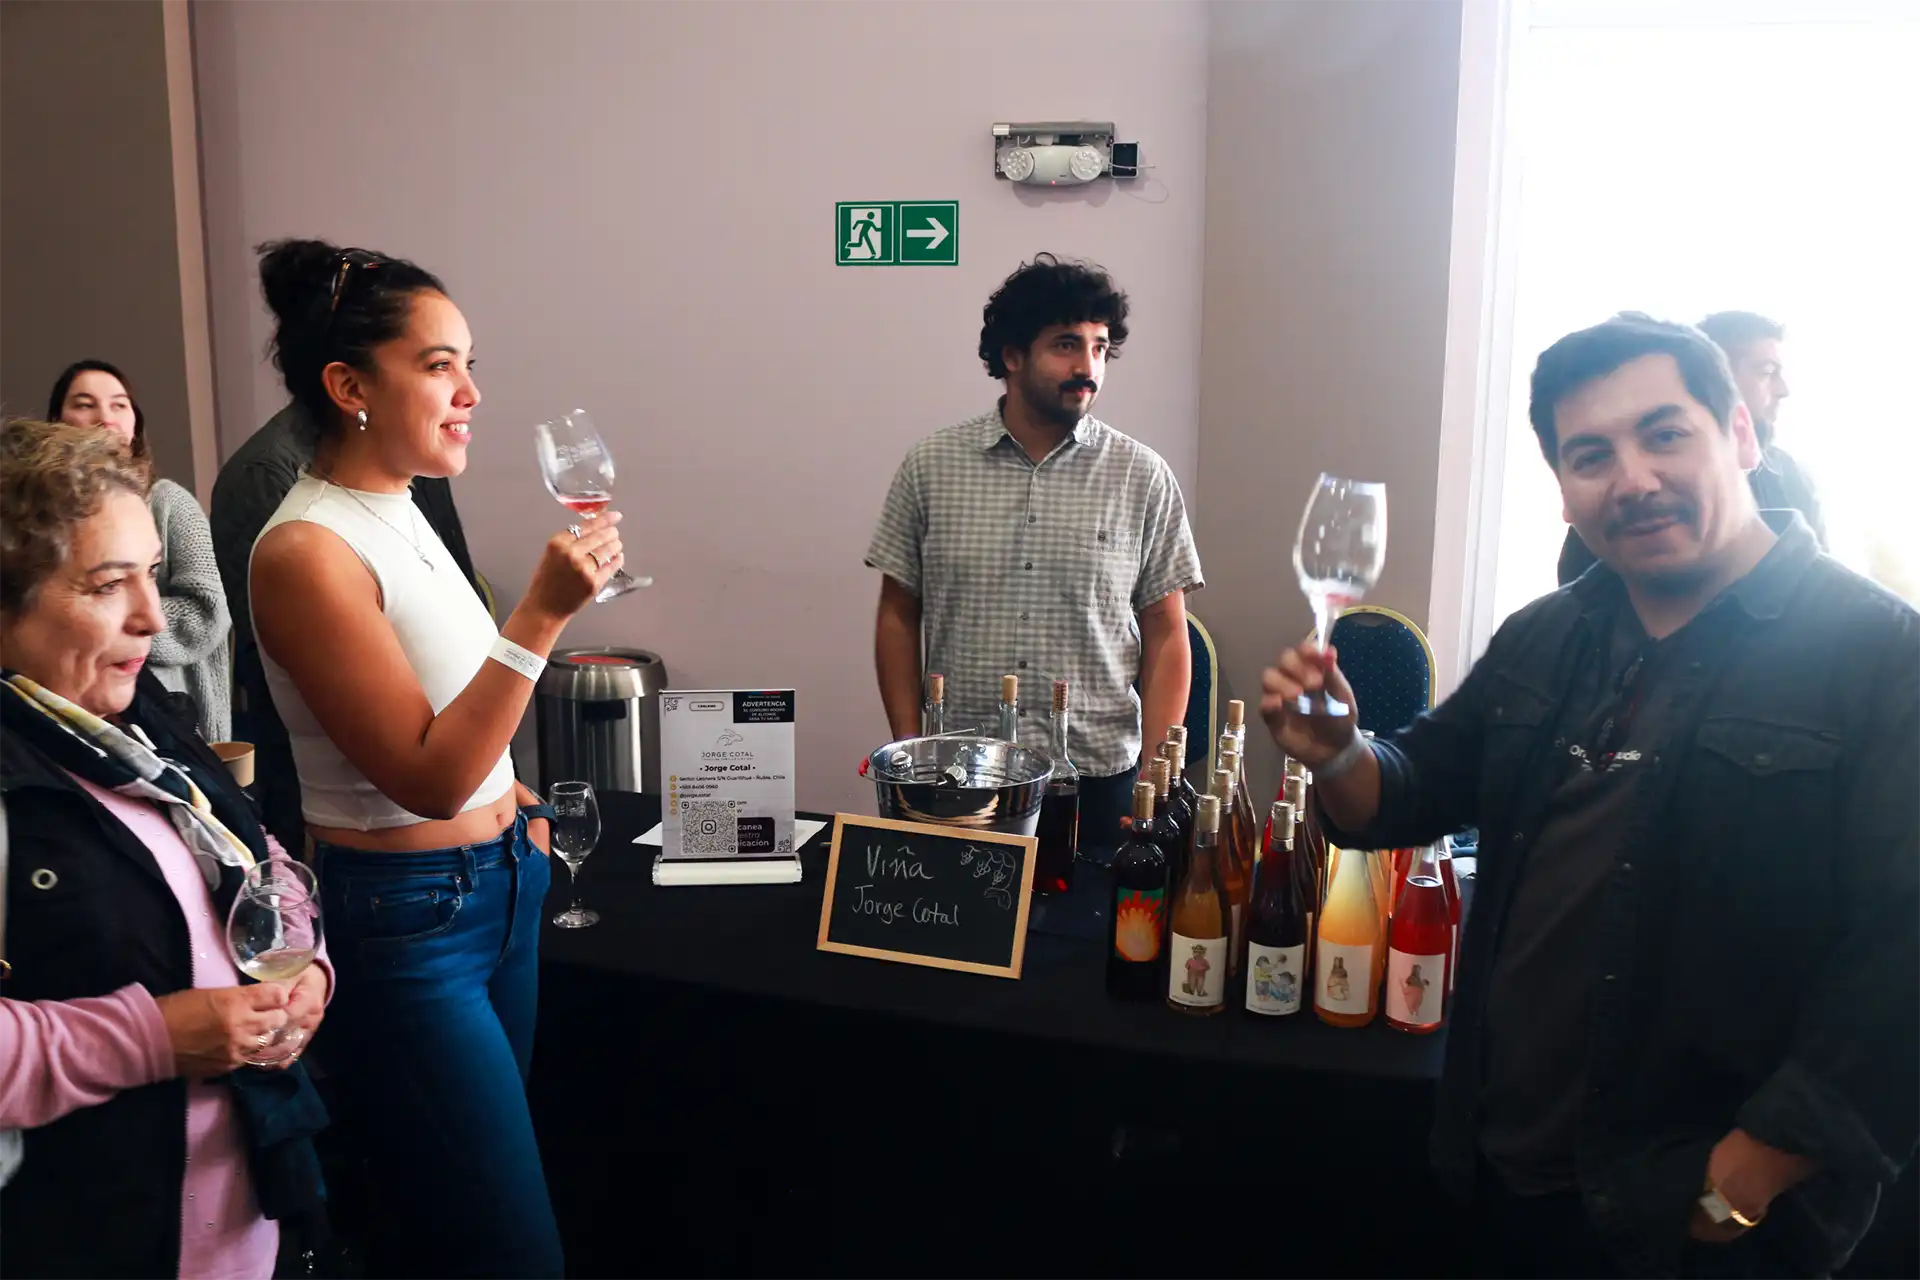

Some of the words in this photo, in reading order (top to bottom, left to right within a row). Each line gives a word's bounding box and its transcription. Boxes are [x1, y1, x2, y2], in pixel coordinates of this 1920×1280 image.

[704, 764, 728, 772] Jorge
[866, 844, 934, 880] Viña
[851, 884, 905, 925] Jorge
[912, 897, 960, 927] Cotal
